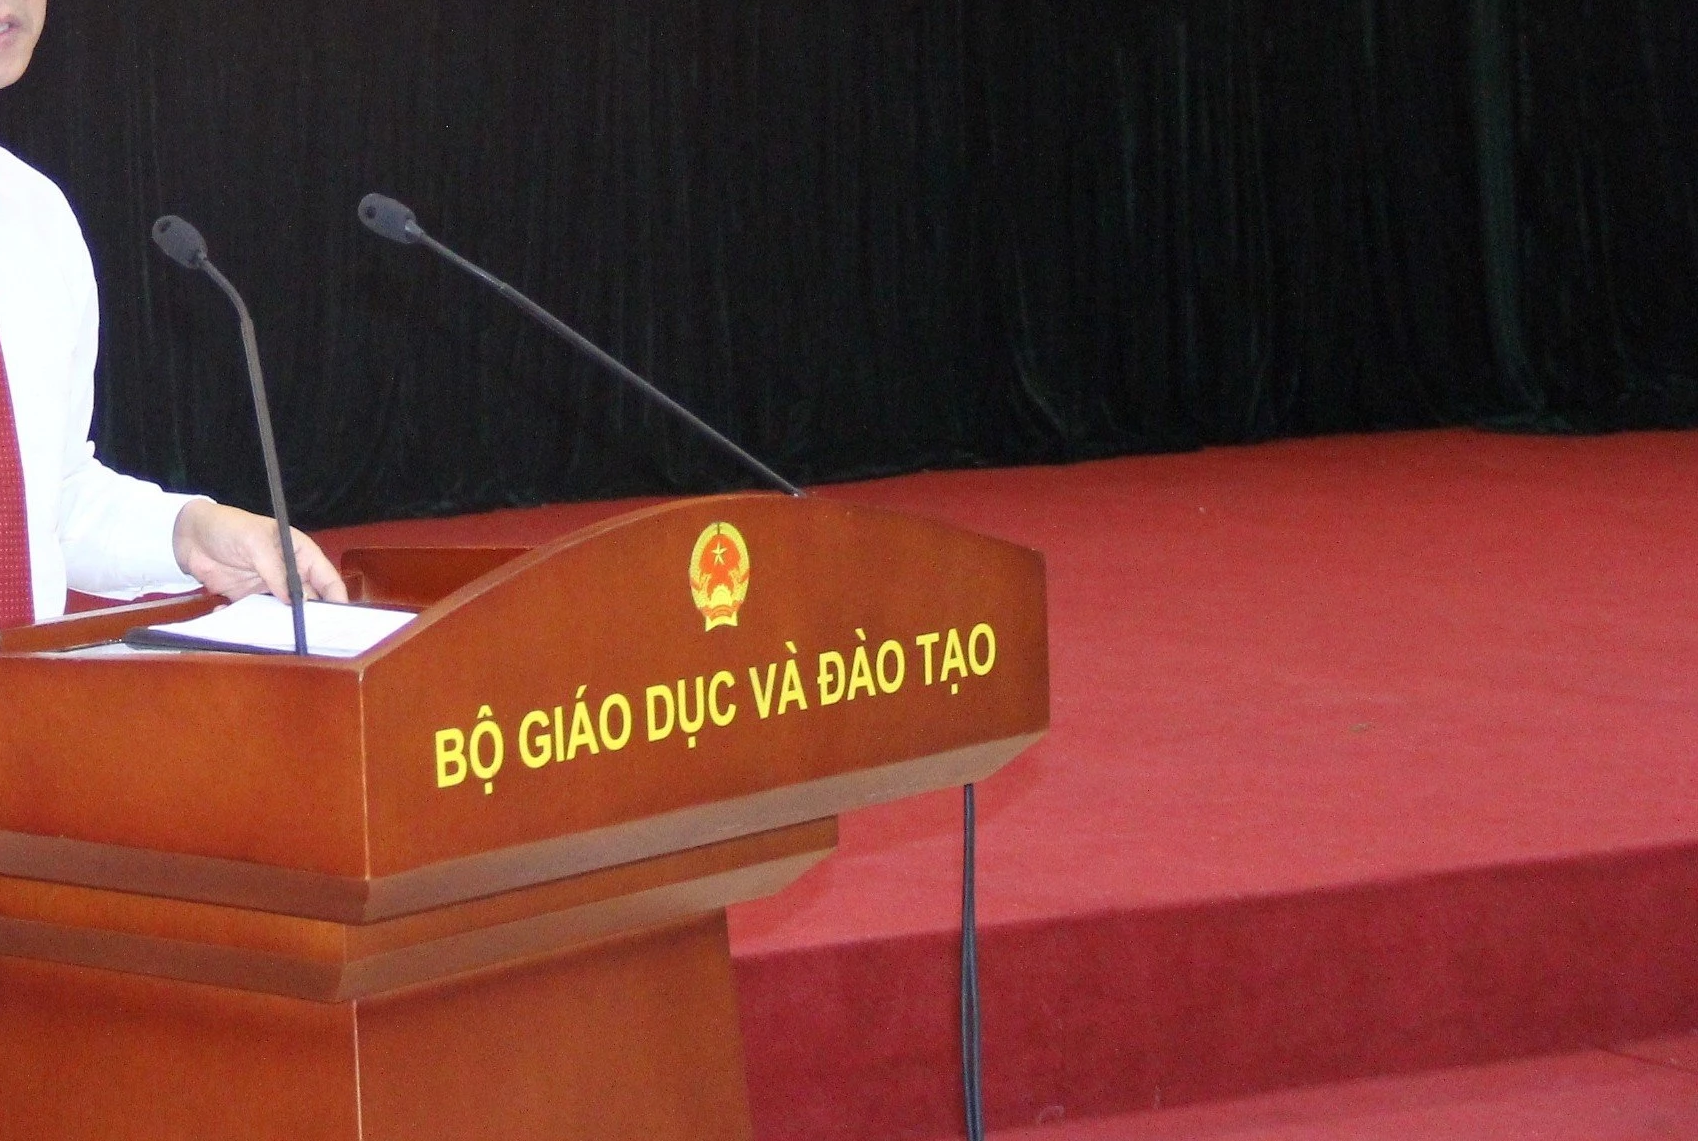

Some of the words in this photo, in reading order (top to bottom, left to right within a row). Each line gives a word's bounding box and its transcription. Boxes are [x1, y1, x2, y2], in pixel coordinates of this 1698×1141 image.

[435, 705, 503, 794] BỘ
[519, 685, 631, 768] GIÁO
[646, 671, 736, 748] DỤC
[749, 641, 807, 718] VÀ
[817, 628, 905, 705] ĐÀO
[916, 623, 995, 694] TẠO
